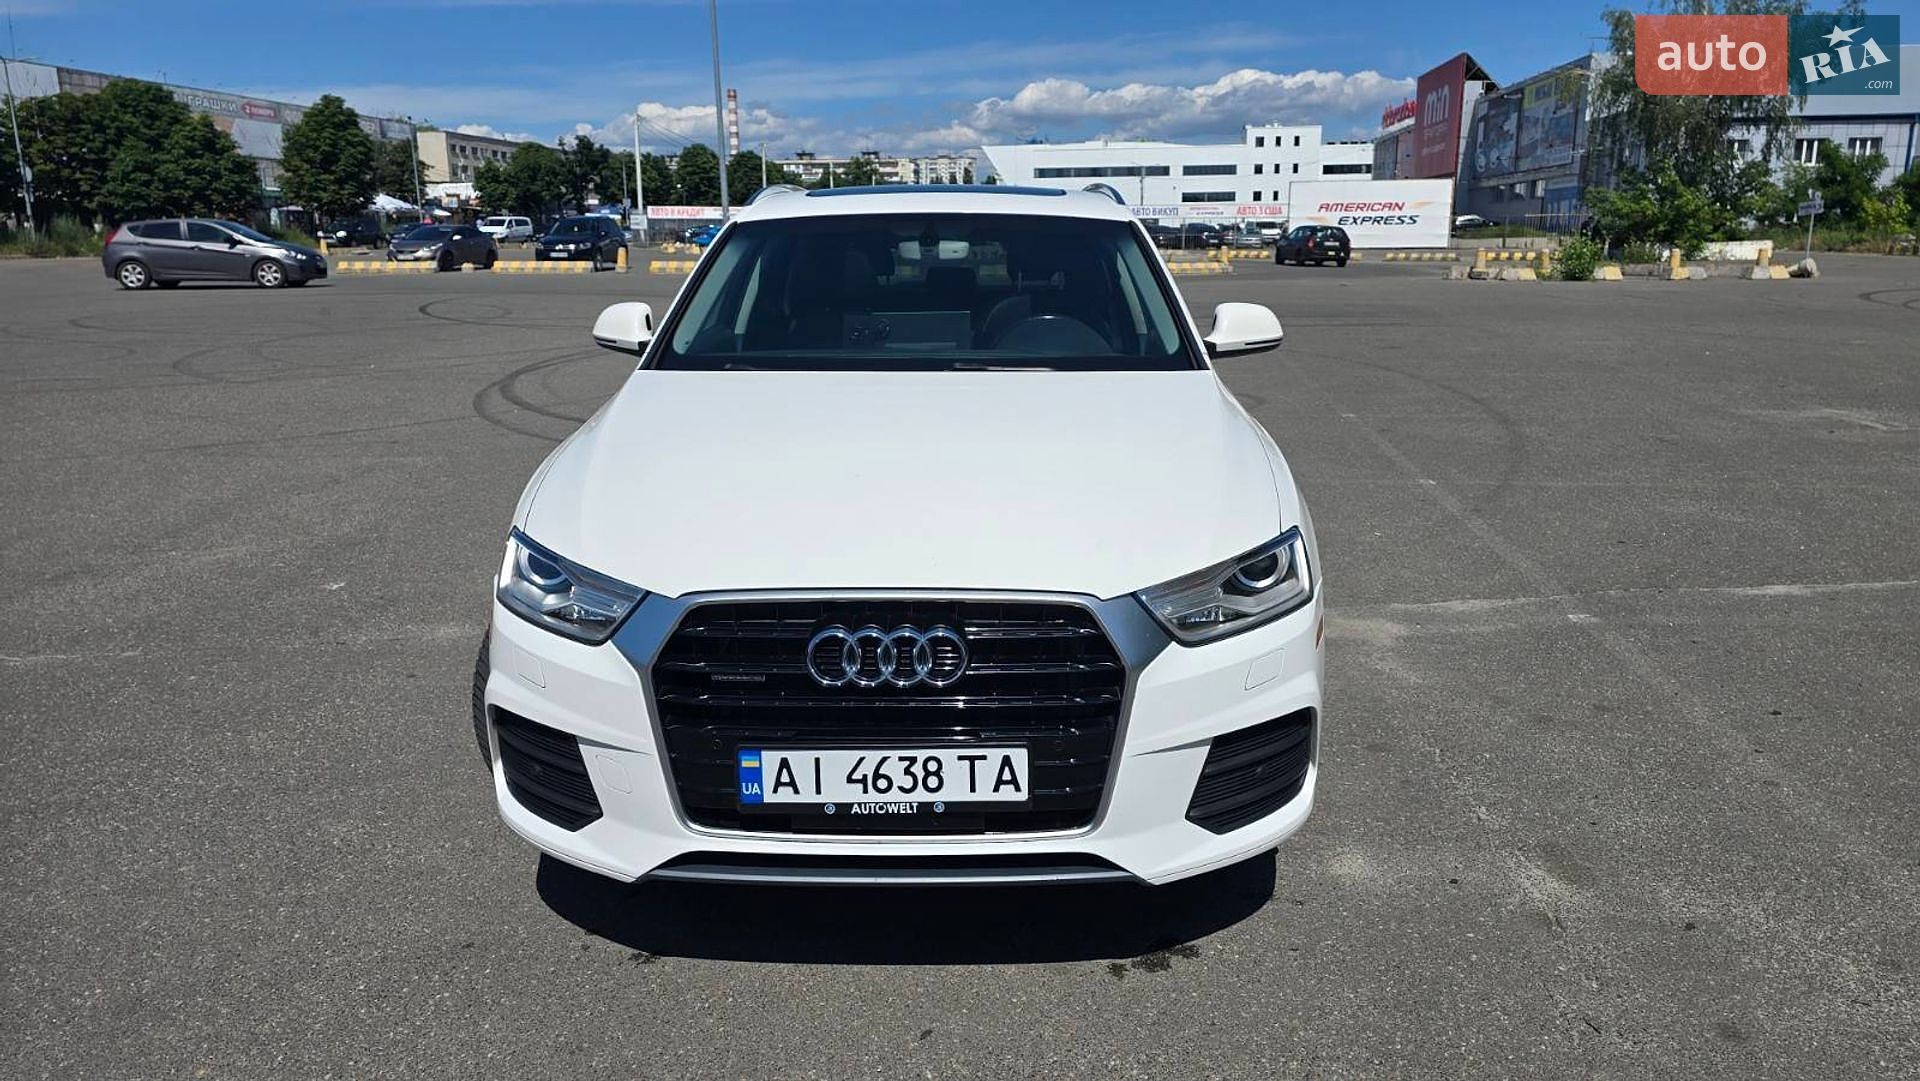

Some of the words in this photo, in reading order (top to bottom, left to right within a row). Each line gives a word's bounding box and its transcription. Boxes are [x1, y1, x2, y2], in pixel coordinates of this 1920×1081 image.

[1318, 201, 1406, 212] AMERICAN
[1337, 214, 1420, 225] EXPRESS
[846, 756, 945, 794] 4638
[957, 754, 1022, 793] TA
[741, 782, 761, 795] UA
[850, 802, 918, 814] AUTOWELT
